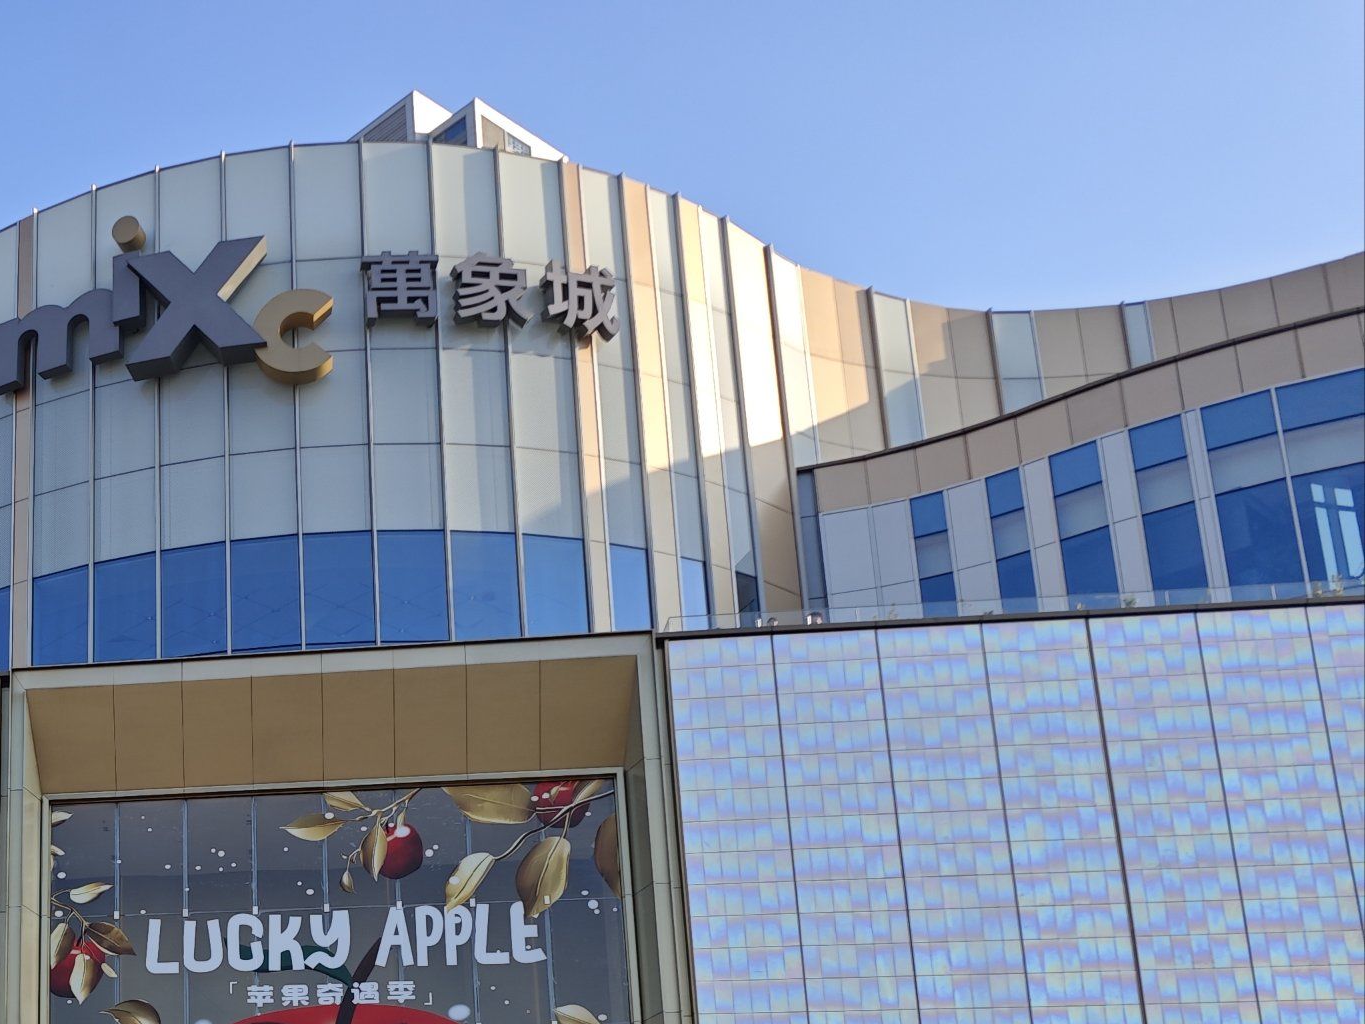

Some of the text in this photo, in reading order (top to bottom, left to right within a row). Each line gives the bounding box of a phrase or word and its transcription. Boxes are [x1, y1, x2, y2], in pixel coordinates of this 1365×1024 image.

[360, 250, 620, 343] 萬象城
[145, 902, 548, 974] LUCKY APPLE
